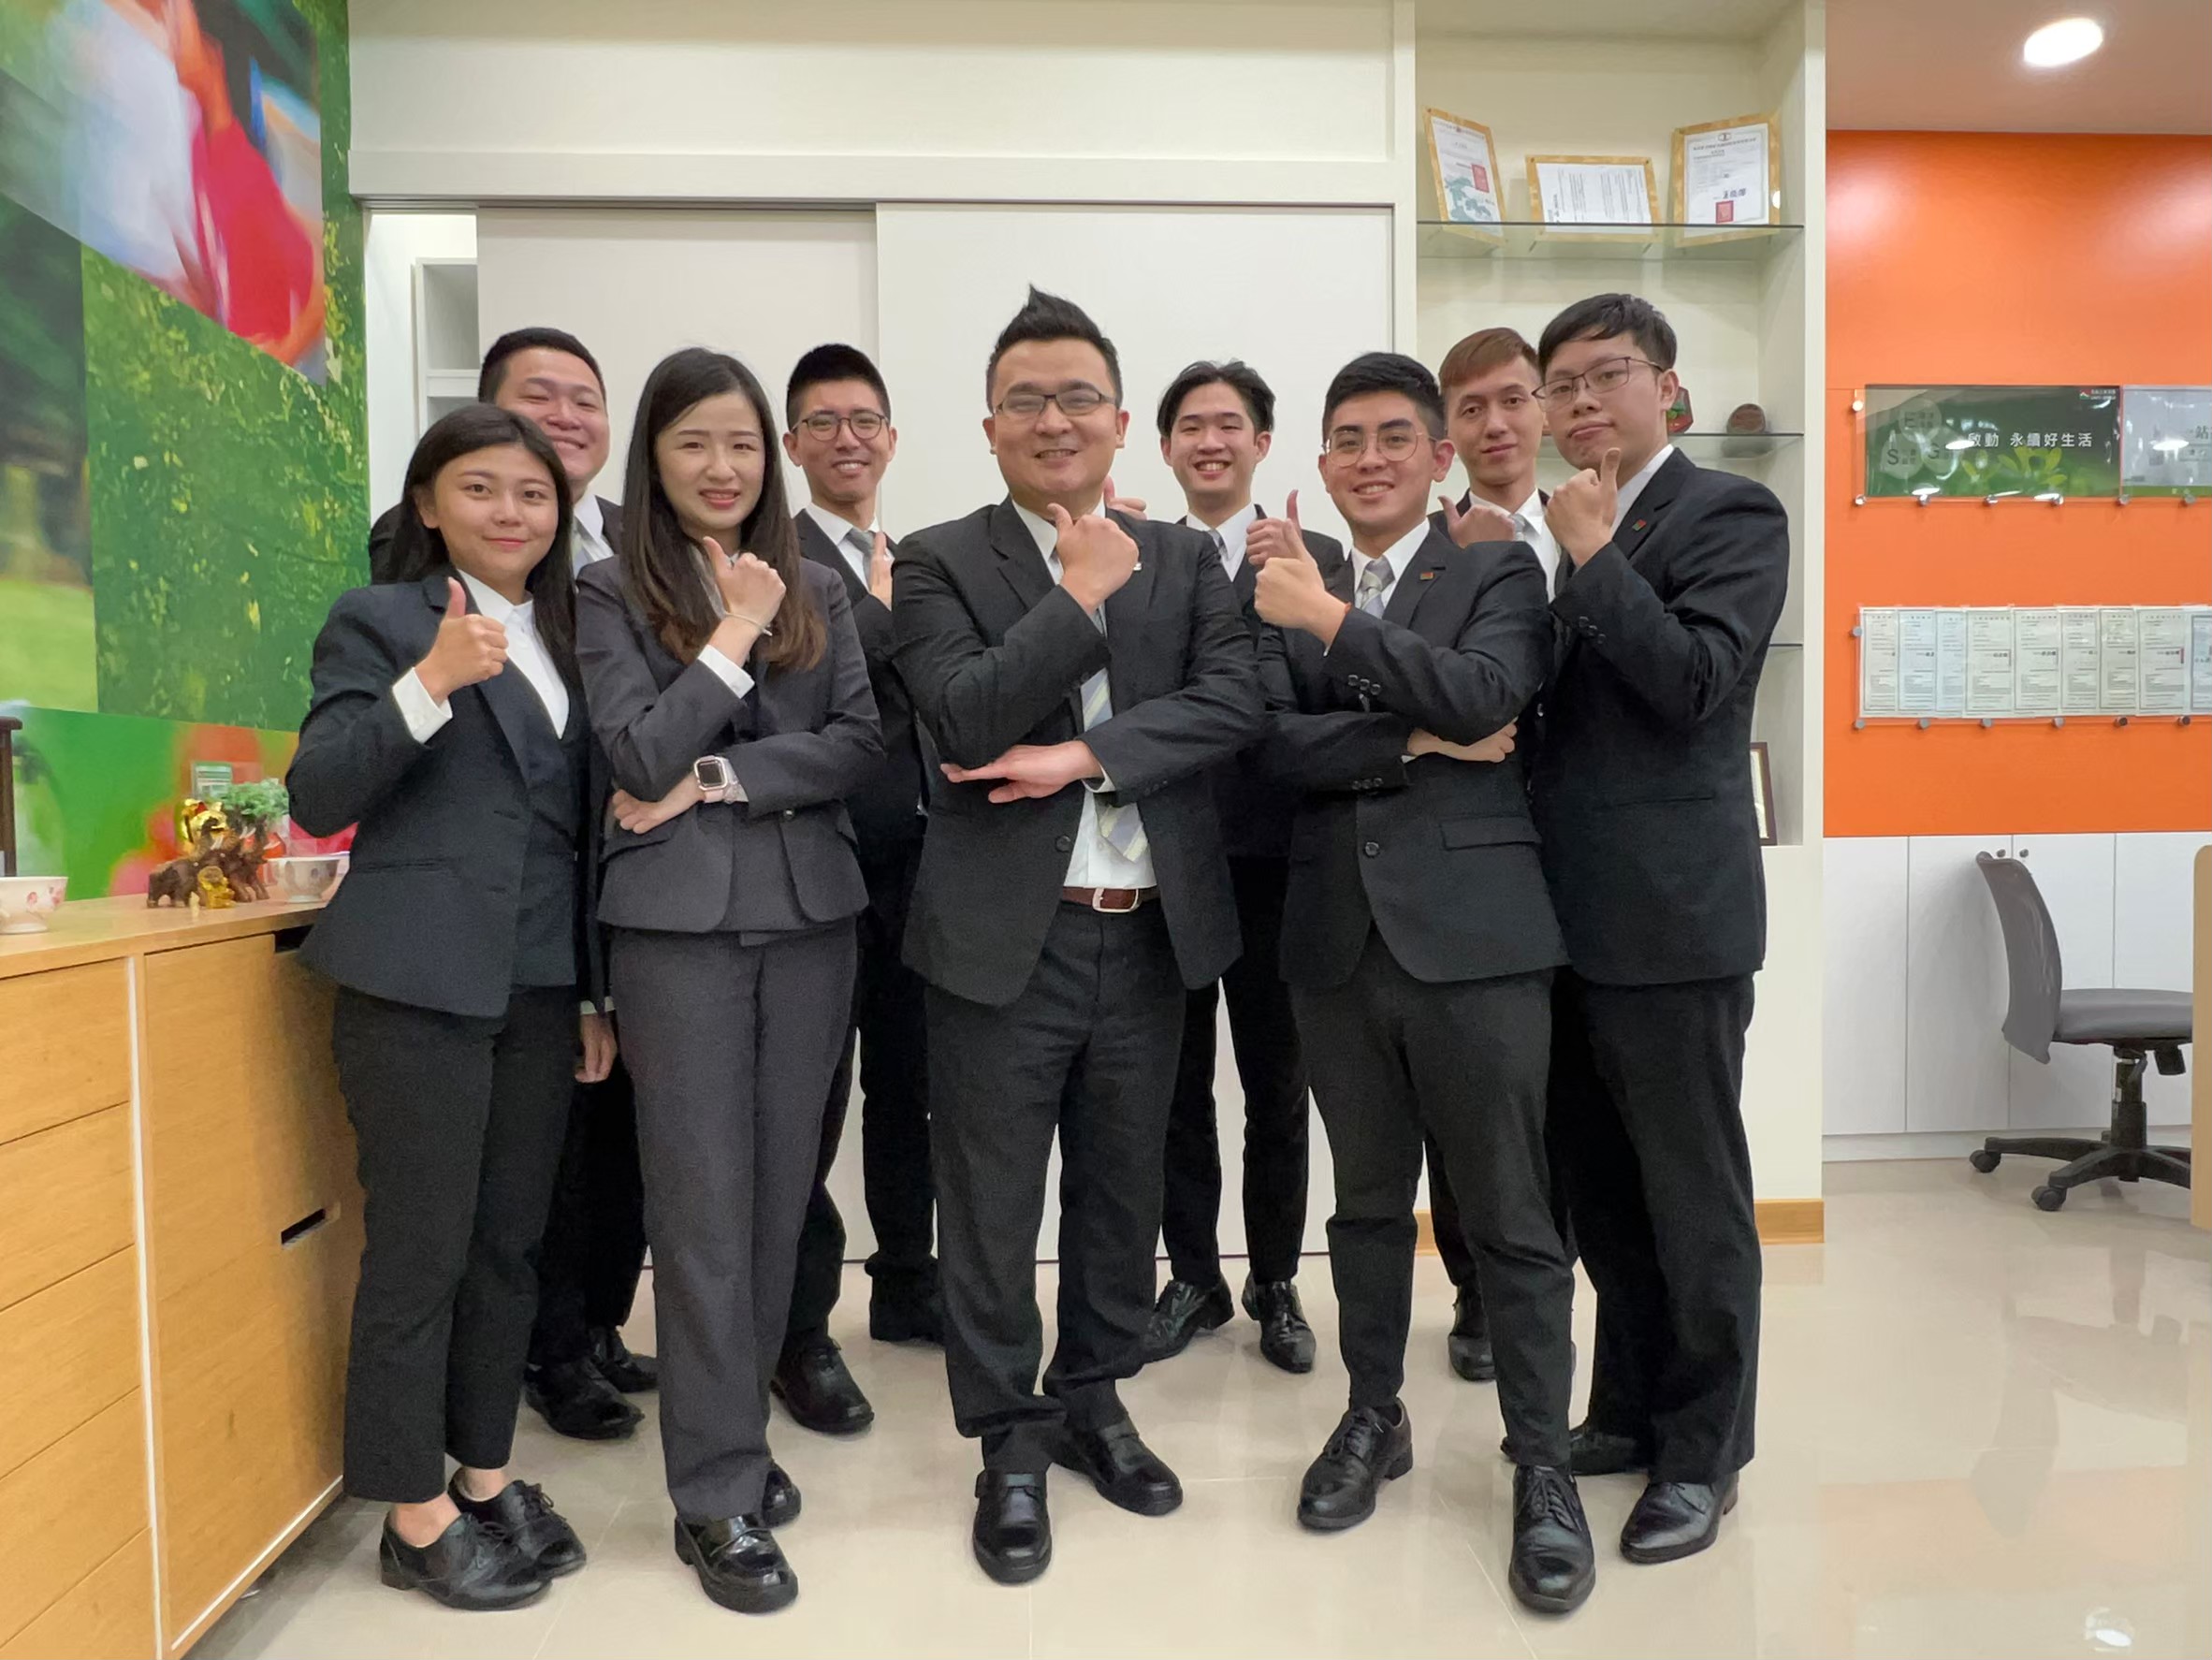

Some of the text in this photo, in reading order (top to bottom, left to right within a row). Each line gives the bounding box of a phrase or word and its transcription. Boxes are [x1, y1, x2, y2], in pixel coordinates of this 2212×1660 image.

[1904, 412, 1916, 429] E
[2010, 432, 2092, 447] 永續好生活
[1887, 448, 1899, 465] S
